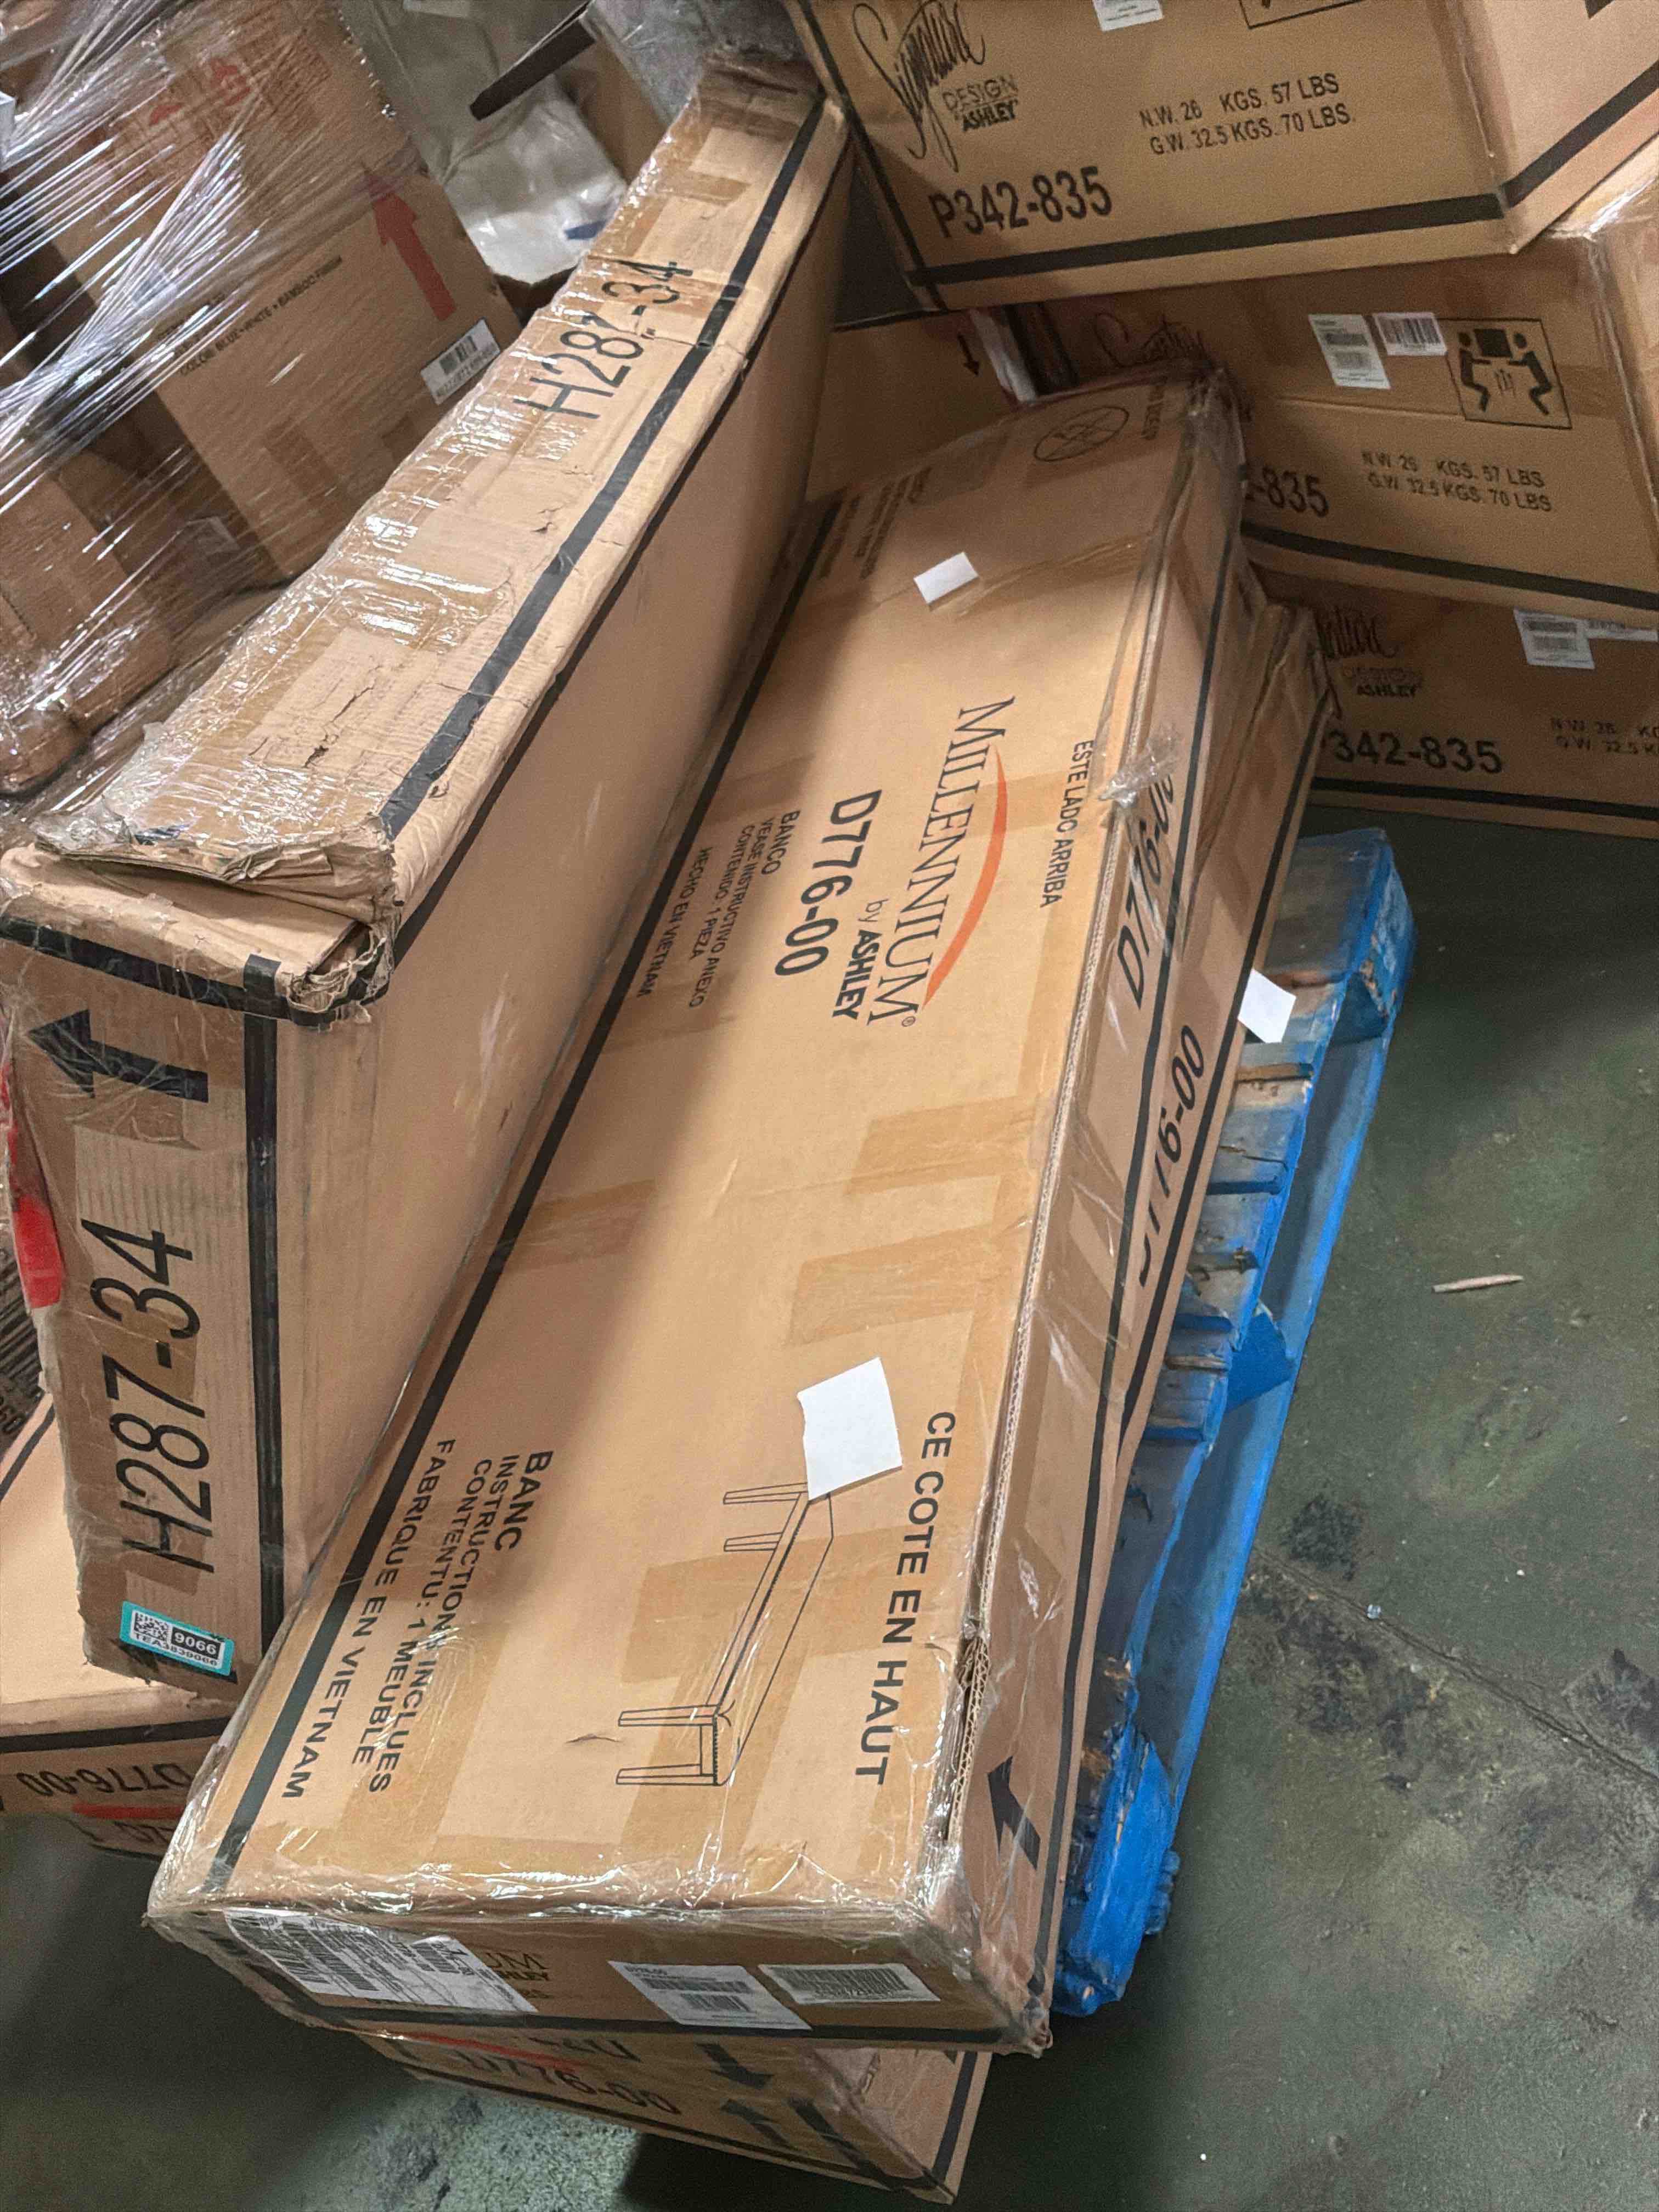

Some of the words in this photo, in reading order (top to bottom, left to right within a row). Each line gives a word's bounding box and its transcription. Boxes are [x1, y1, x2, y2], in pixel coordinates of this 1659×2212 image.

[941, 74, 1019, 111] DESIGN
[962, 99, 1017, 132] ASHLEY
[1181, 99, 1203, 122] 26
[1271, 81, 1291, 104] 57
[1297, 72, 1340, 100] LBS
[1191, 126, 1229, 149] 32.5
[1281, 112, 1305, 134] 70
[928, 166, 1112, 238] P342-835
[514, 256, 693, 420] H287-34
[1482, 466, 1502, 483] 57
[1505, 467, 1545, 488] LBS
[1066, 740, 1094, 783] ESTE
[1321, 730, 1503, 774] 342-835
[1056, 785, 1086, 833] LADO
[761, 810, 801, 875] BANCO
[680, 846, 713, 899] HECHO
[774, 789, 883, 976] D776-00
[1039, 839, 1075, 909] ARRIBA
[668, 901, 689, 924] EN
[857, 898, 889, 923] by
[636, 924, 681, 998] VIETNAM
[831, 930, 883, 1020] ASHLEY
[81, 1219, 215, 1573] H287-34
[921, 1410, 956, 1459] CE
[374, 1438, 456, 1587] FABRIQUE
[494, 1451, 554, 1551] BANC
[896, 1471, 944, 1576] COTE
[174, 1632, 217, 1655] 9066
[352, 1595, 387, 1638] EN
[408, 1619, 426, 1629] 1
[882, 1589, 921, 1644] EN
[281, 1646, 366, 1799] VIETNAM
[352, 1640, 418, 1765] MEUBLE
[369, 1659, 437, 1793] INCLUES
[855, 1659, 906, 1785] HAUT
